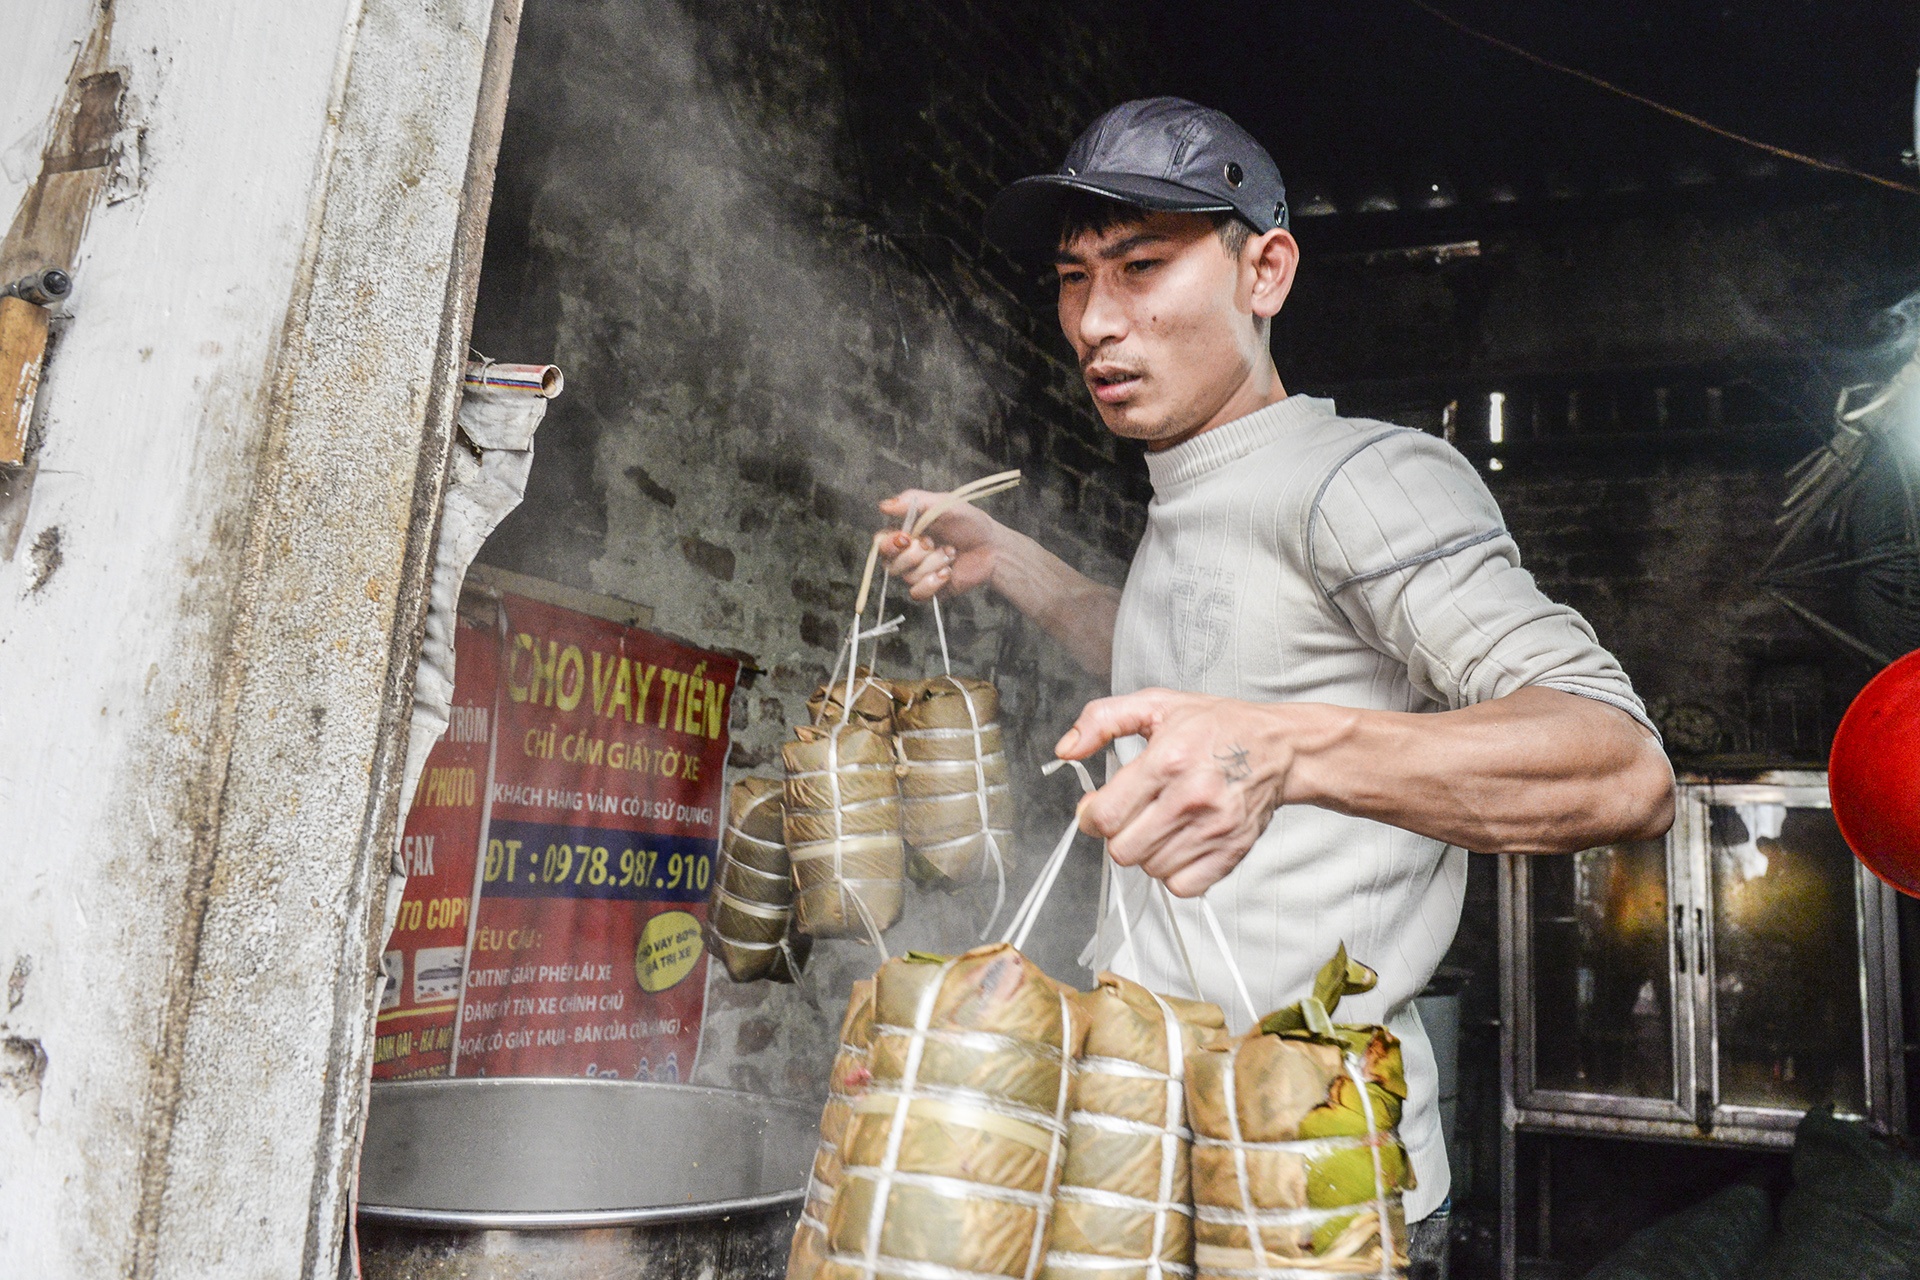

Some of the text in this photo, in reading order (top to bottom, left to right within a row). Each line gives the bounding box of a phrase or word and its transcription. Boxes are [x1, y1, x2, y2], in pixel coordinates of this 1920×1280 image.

[508, 633, 584, 712] CHO
[592, 651, 657, 725] VAY
[524, 724, 558, 760] CHỈ
[681, 753, 701, 782] XE
[424, 767, 476, 807] PHOTO
[404, 836, 435, 877] FAX
[484, 838, 523, 883] ĐT
[542, 844, 711, 891] 0978.987.910
[597, 964, 613, 982] XE
[536, 997, 558, 1016] XE
